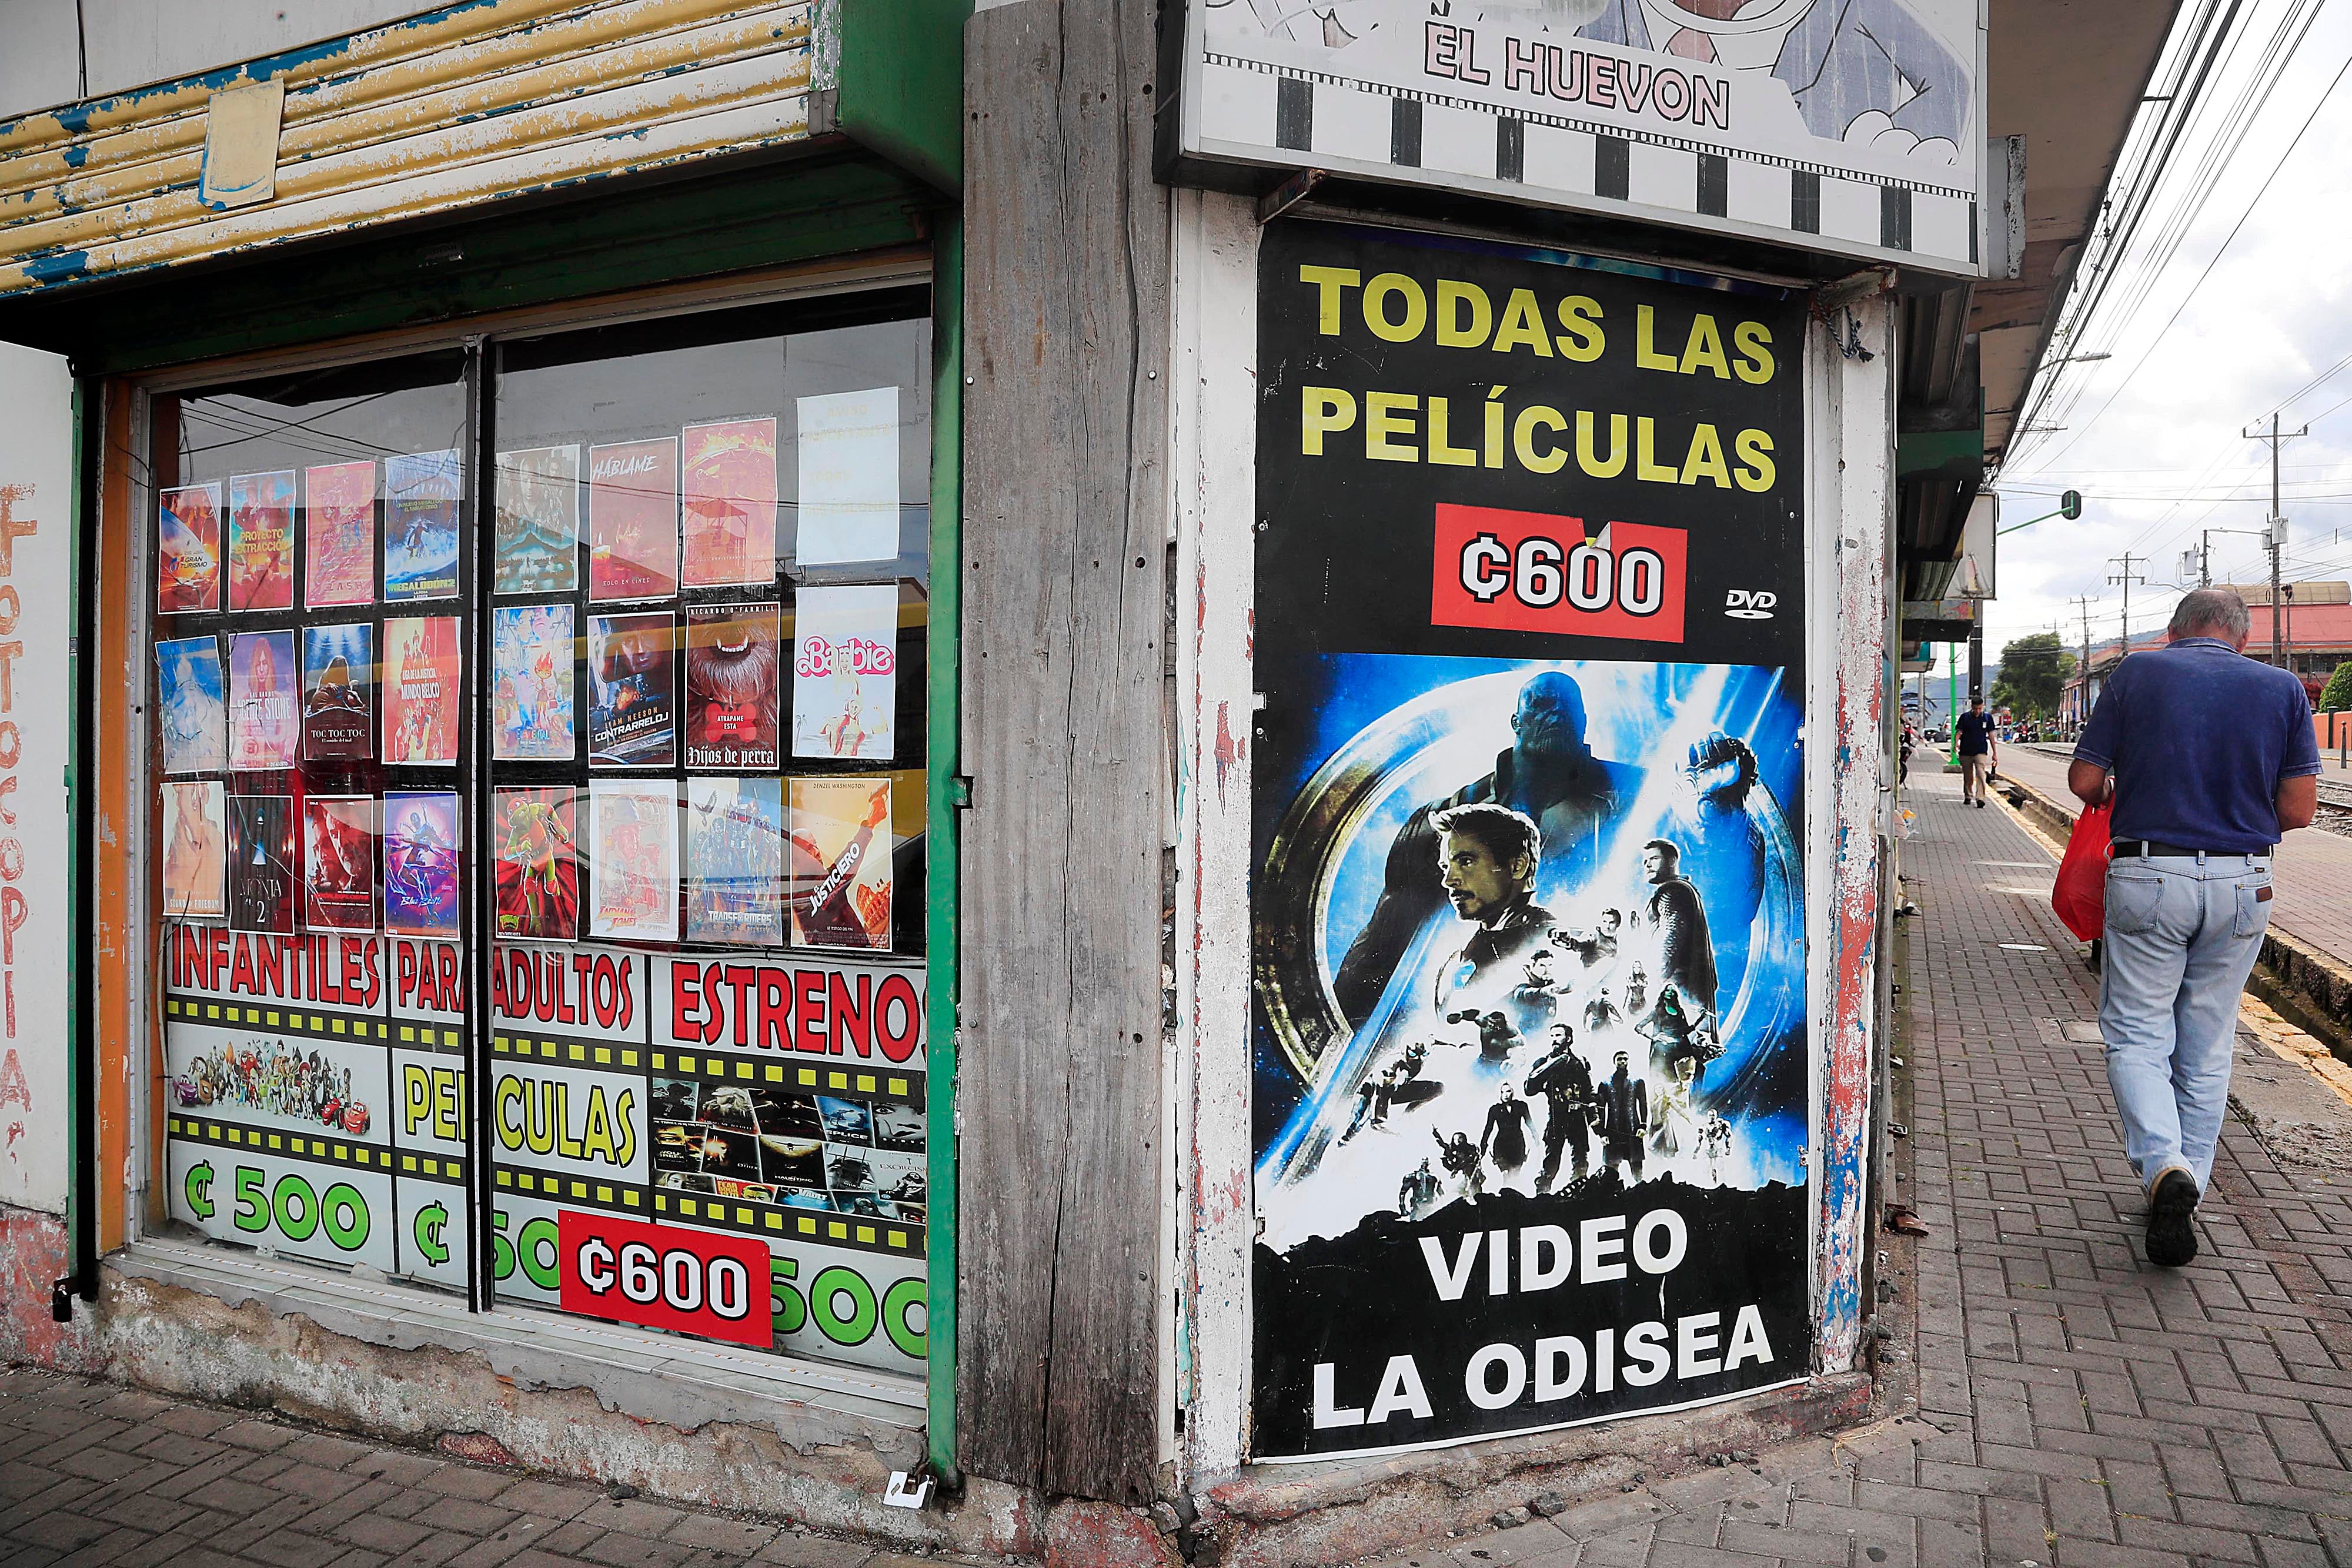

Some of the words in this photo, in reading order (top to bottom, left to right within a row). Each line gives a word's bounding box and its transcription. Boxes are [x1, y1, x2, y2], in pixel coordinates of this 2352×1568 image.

[1424, 21, 1491, 83] EL
[1505, 36, 1730, 131] HUEVON
[1300, 265, 1605, 363] TODAS
[1636, 305, 1776, 385] LAS
[1302, 386, 1776, 493] PELÍCULAS
[592, 455, 659, 481] HÁBLAME
[236, 539, 290, 554] EXTRACCIÓN
[240, 528, 284, 541] PROYECTO
[1726, 589, 1777, 611] DVD
[796, 635, 894, 677] Barbie
[401, 683, 421, 700] MUNDO
[265, 697, 291, 720] STONE
[627, 706, 658, 722] NEESON
[717, 714, 744, 722] ATRÁPAME
[311, 730, 326, 738] TOC
[328, 729, 345, 738] TOC
[347, 729, 365, 737] TOC
[595, 711, 669, 743] CONTRARRELOJ
[688, 745, 721, 767] Hijos
[724, 746, 738, 764] de
[741, 750, 774, 767] perra
[809, 842, 860, 918] JUSTICIERO
[195, 899, 219, 908] FREEDOM
[256, 901, 266, 922] 2
[400, 897, 418, 906] Blue
[172, 924, 380, 1009] INFANTILES
[396, 940, 465, 1013] PAR
[493, 945, 632, 1032] ADULTOS
[671, 961, 927, 1062] ESTRENO
[827, 1129, 868, 1140] SPLICE
[799, 1189, 828, 1200] VAULT
[235, 1165, 370, 1252] 500
[1418, 1209, 1688, 1301] VIDEO
[771, 1255, 927, 1360] 500
[1312, 1353, 1435, 1429] LA
[1464, 1304, 1774, 1410] ODISEA
